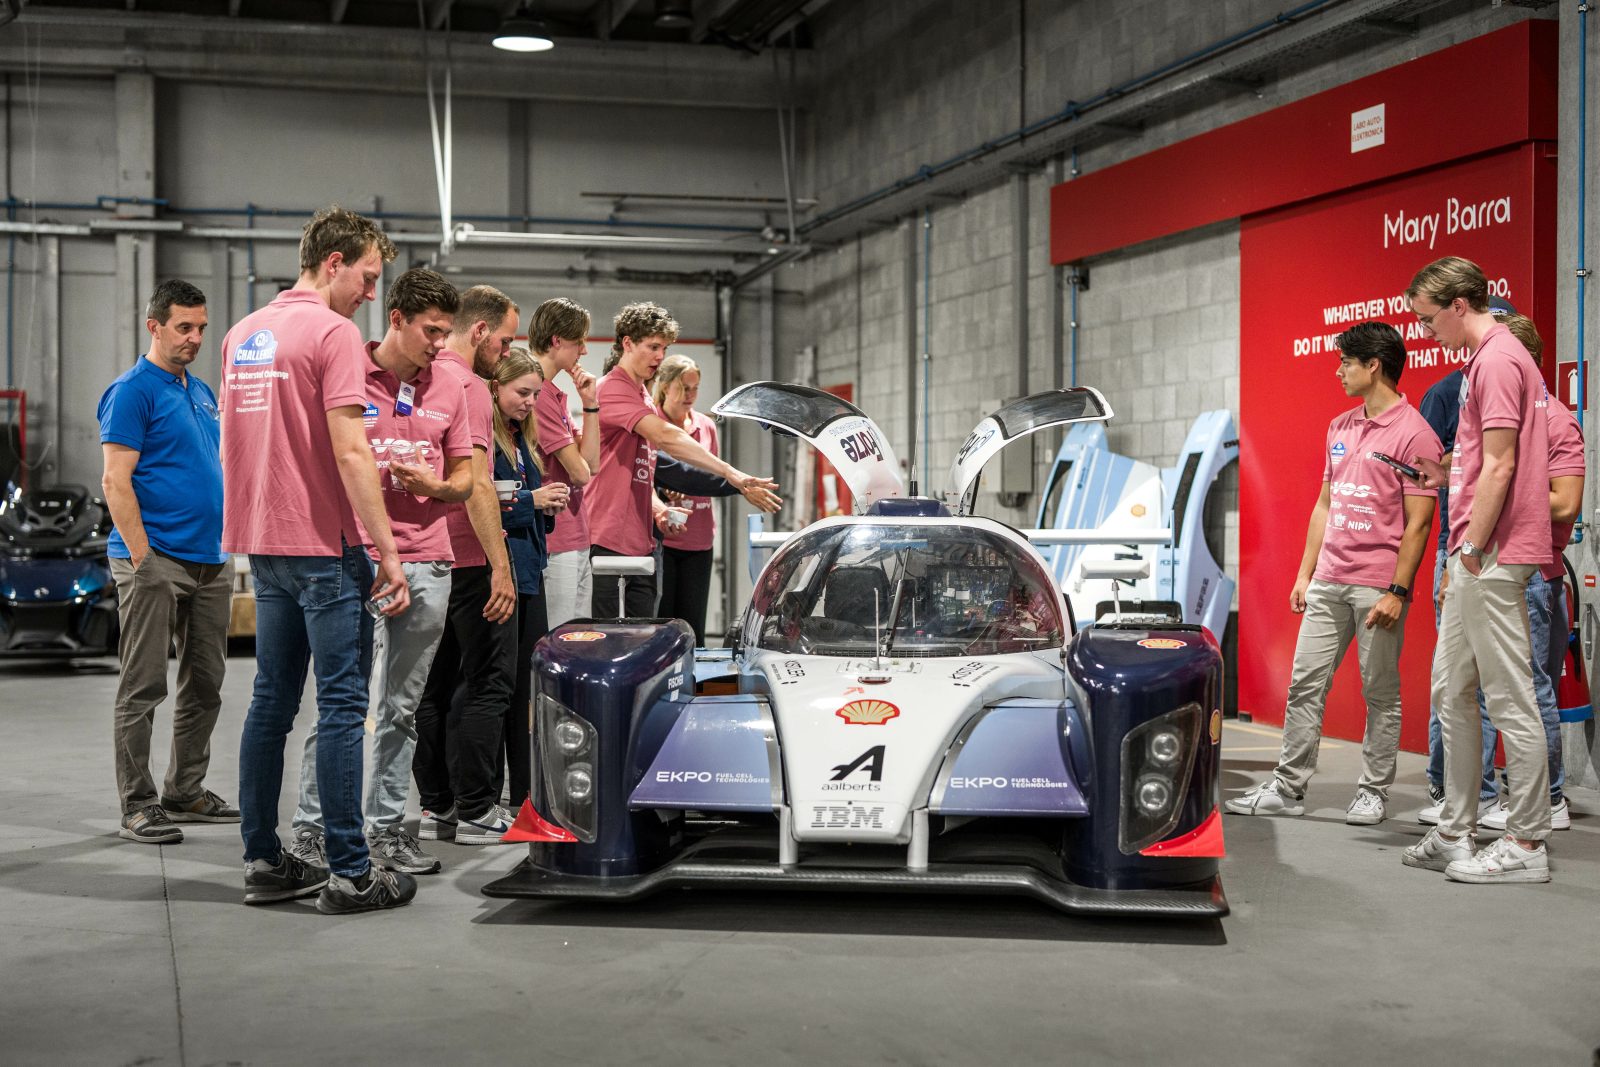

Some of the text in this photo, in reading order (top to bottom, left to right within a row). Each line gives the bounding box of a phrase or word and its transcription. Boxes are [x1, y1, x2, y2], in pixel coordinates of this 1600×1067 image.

[1353, 120, 1366, 131] LABO
[1384, 196, 1511, 250] Mary Barra
[1323, 298, 1385, 326] WHATEVER
[1293, 336, 1310, 357] DO
[1311, 335, 1322, 354] IT
[1407, 346, 1470, 369] THAT YOU
[656, 771, 712, 783] EKPO
[821, 782, 881, 791] aalberts
[950, 777, 1008, 789] EKPO
[810, 806, 885, 828] IBM
